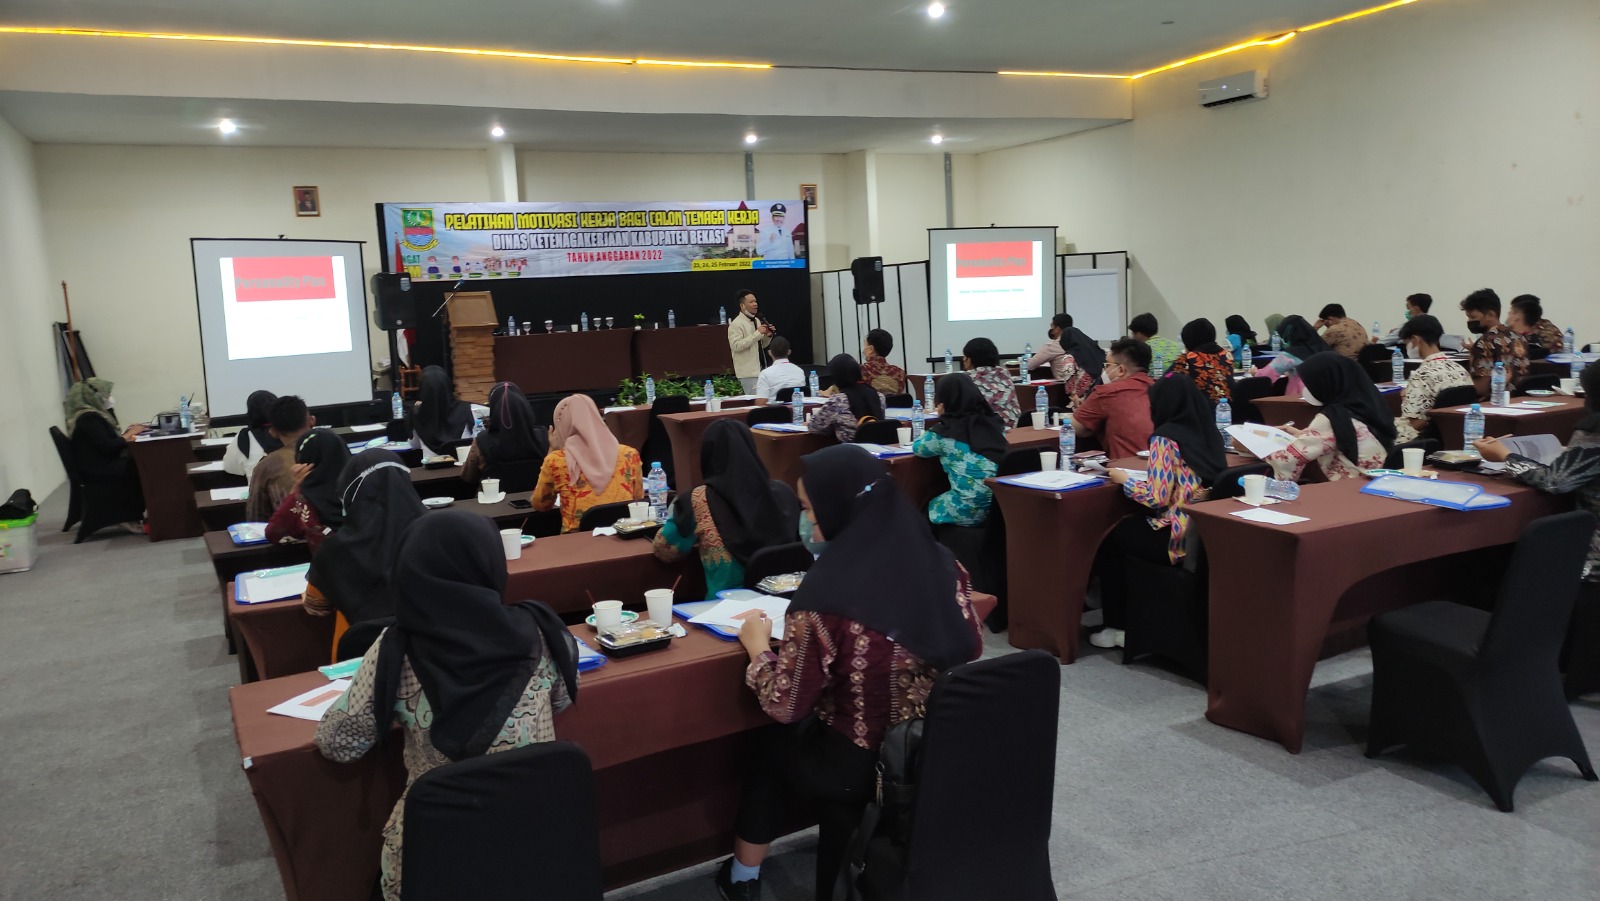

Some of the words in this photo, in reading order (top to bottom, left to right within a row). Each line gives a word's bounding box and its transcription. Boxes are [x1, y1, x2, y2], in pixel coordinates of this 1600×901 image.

[445, 213, 515, 230] PELATIHAN
[516, 212, 578, 229] MOTIVASI
[580, 211, 617, 228] KERJA
[618, 211, 648, 227] BAGI
[649, 210, 683, 226] CALON
[684, 210, 725, 225] TENAGA
[727, 209, 759, 225] KERJA
[492, 233, 528, 250] DINAS
[529, 231, 629, 249] KETENAGAKERJAAN
[630, 229, 688, 246] KABUPATEN
[689, 229, 725, 245] BEKASI
[567, 252, 594, 262] TAHUN
[596, 250, 639, 261] ANGGARAN
[641, 249, 662, 260] 2022
